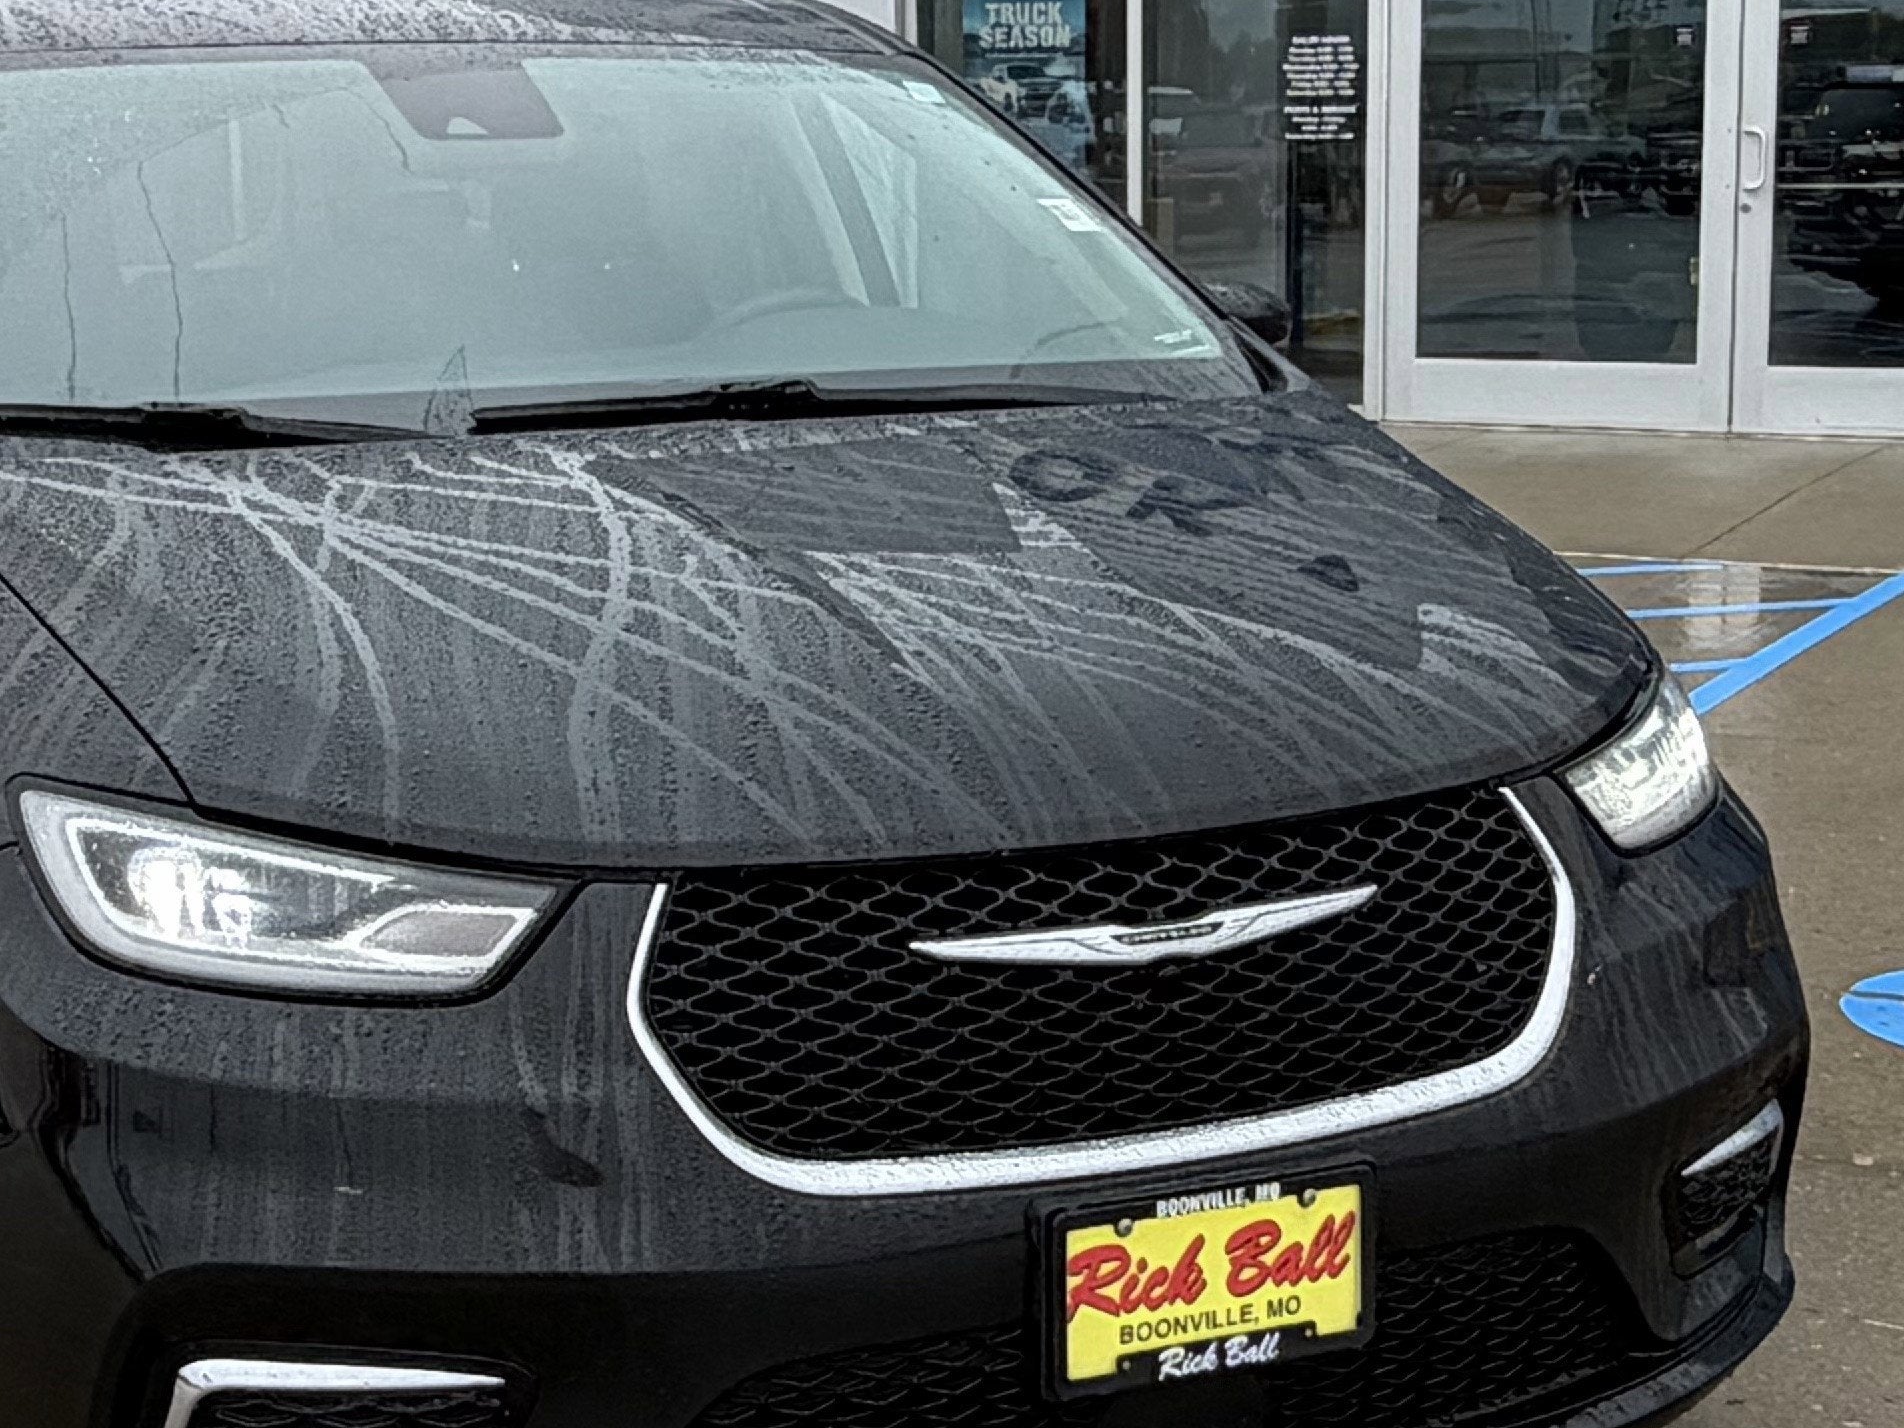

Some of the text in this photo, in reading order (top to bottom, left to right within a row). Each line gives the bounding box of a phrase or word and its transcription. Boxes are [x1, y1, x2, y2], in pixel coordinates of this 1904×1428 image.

[984, 1, 1063, 24] TRUCK
[978, 24, 1072, 49] SEASON
[1156, 1182, 1280, 1218] BOONVILLE, MO
[1067, 1210, 1356, 1323] Rick Ball
[1119, 1295, 1302, 1346] BOONVILLE, MO
[1158, 1332, 1281, 1382] Rick Ball
